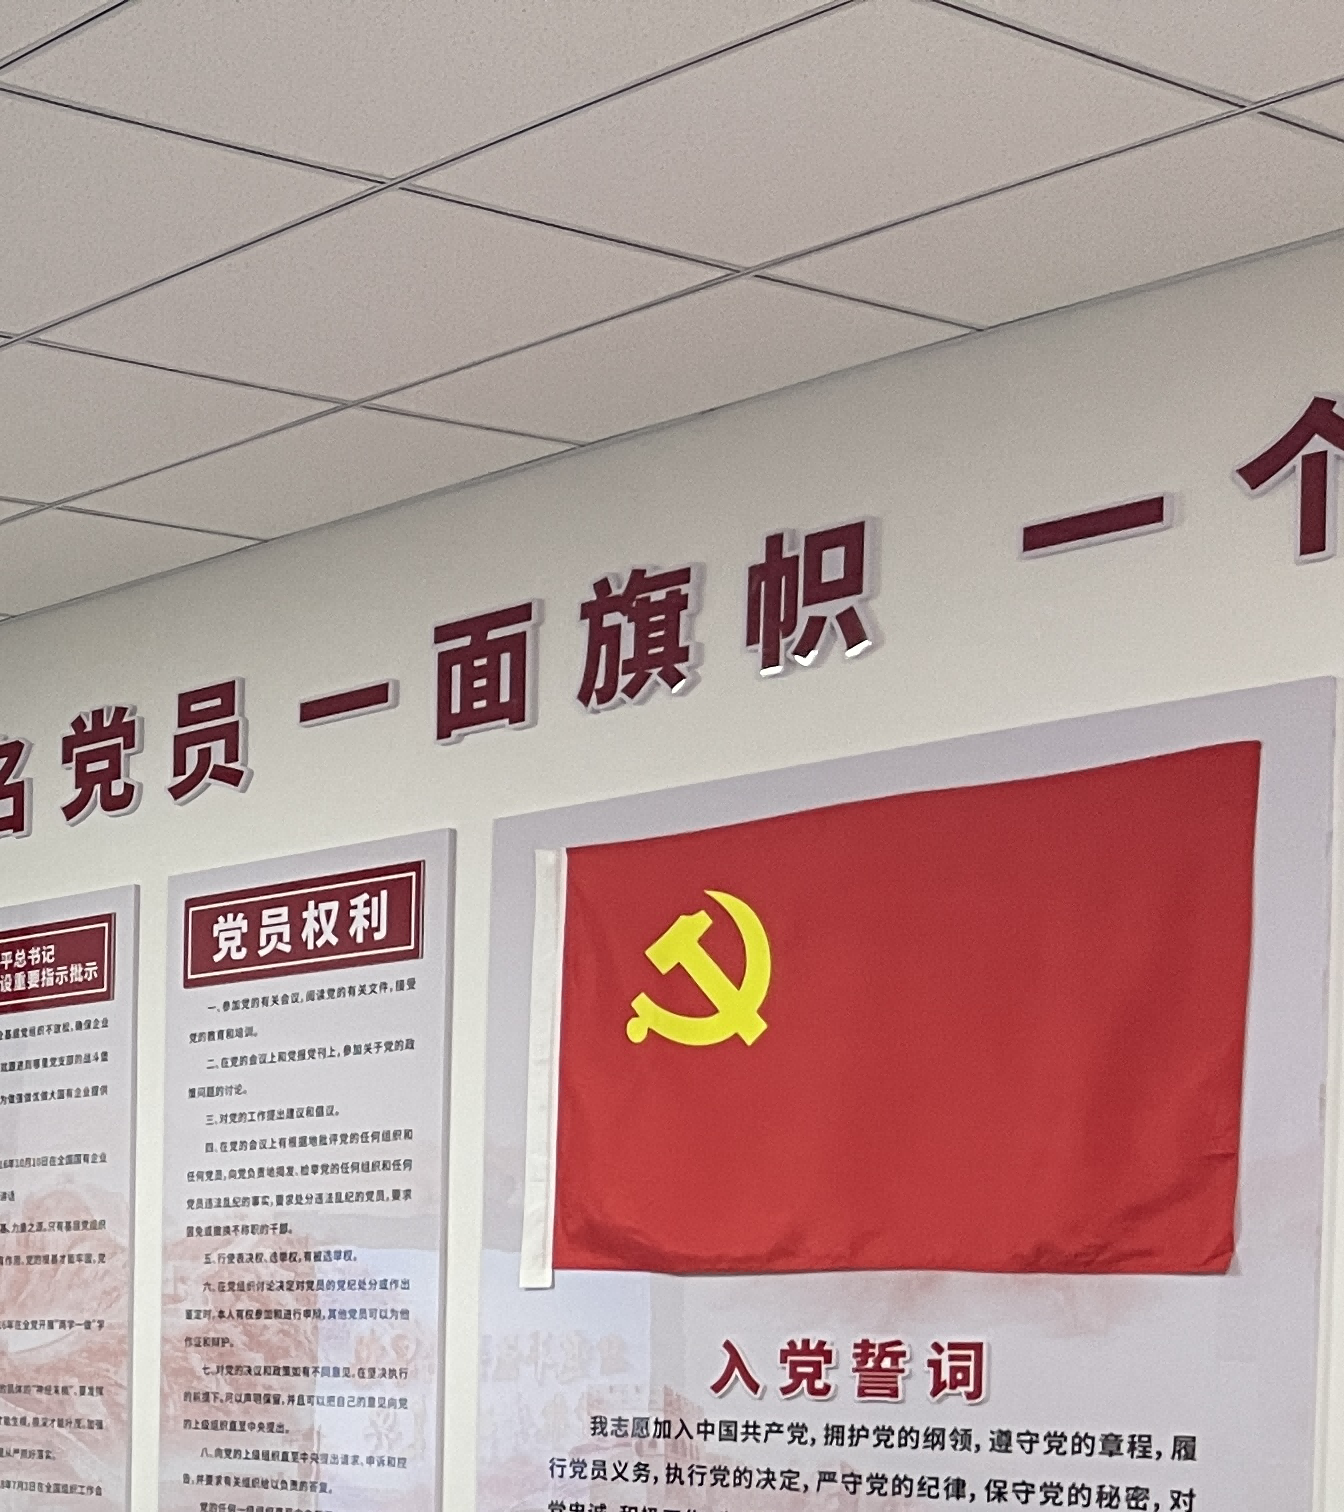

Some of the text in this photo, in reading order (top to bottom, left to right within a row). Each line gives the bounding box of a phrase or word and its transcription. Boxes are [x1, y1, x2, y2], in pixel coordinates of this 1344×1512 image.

[212, 889, 388, 964] 党员权利
[710, 1338, 984, 1401] 入党誓词
[590, 1415, 1197, 1461] 我志愿加入中国共产党，拥护党的纲领，遵守党的章程，履
[549, 1457, 1196, 1512] 行党员义务，执行党的决定，严守党的纪律，保守党的秘密，对
